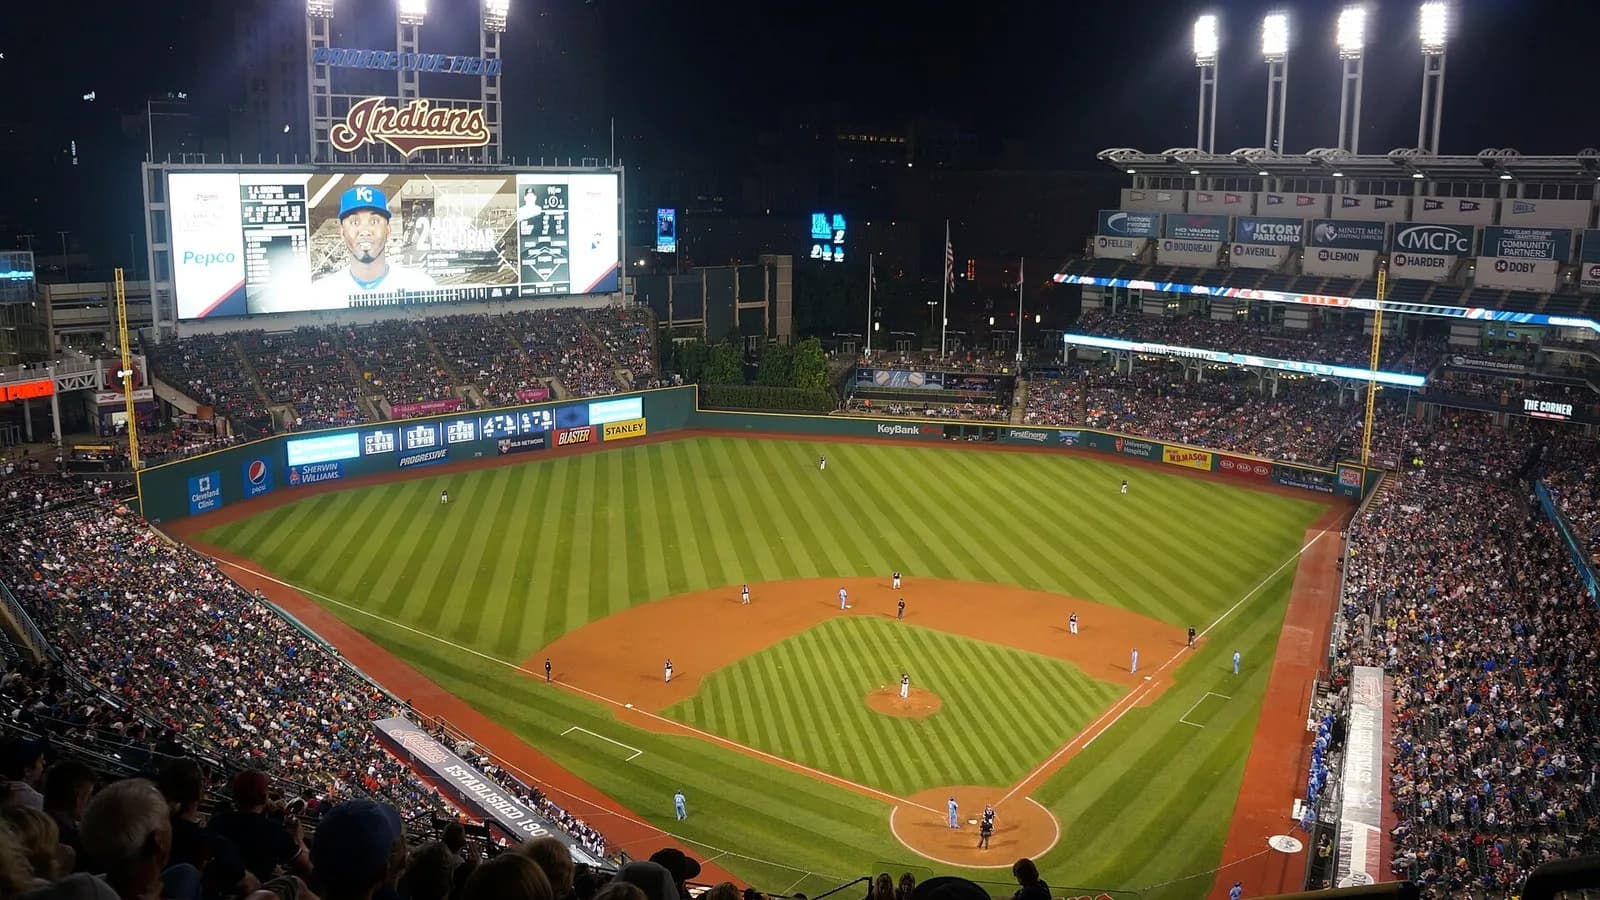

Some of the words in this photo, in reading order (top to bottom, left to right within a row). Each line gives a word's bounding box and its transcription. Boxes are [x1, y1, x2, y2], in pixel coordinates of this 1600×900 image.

[314, 47, 446, 72] PROGRESSIVE
[450, 56, 502, 76] FIELD
[330, 96, 490, 157] Indians
[356, 187, 373, 203] KC
[416, 216, 431, 251] 2
[1253, 233, 1276, 241] PARK
[1276, 234, 1300, 242] OHIO
[1107, 240, 1133, 249] FELLER
[1174, 242, 1213, 252] BOUDREAU
[1408, 231, 1468, 252] MCPc
[1502, 240, 1551, 250] COMMUNITY
[1245, 247, 1277, 257] AVERILL
[1330, 252, 1360, 262] LEMON
[1504, 249, 1546, 257] PARTNERS
[183, 251, 235, 267] Pepco
[1408, 256, 1445, 267] HARDER
[1496, 262, 1506, 270] 14
[1509, 262, 1536, 273] DOBY
[1524, 399, 1539, 412] THE
[1539, 401, 1573, 416] CORNER
[606, 424, 643, 435] STANLEY
[877, 424, 920, 435] KeyBank
[558, 429, 590, 446] BLASTER
[1124, 439, 1153, 451] University
[400, 448, 448, 466] PROGRESSIVE
[1124, 447, 1150, 457] Hospitals
[301, 463, 338, 475] SHERWIN
[191, 488, 220, 503] Cleveland
[198, 500, 215, 510] Clinic
[444, 763, 526, 820] ESTABLISHED
